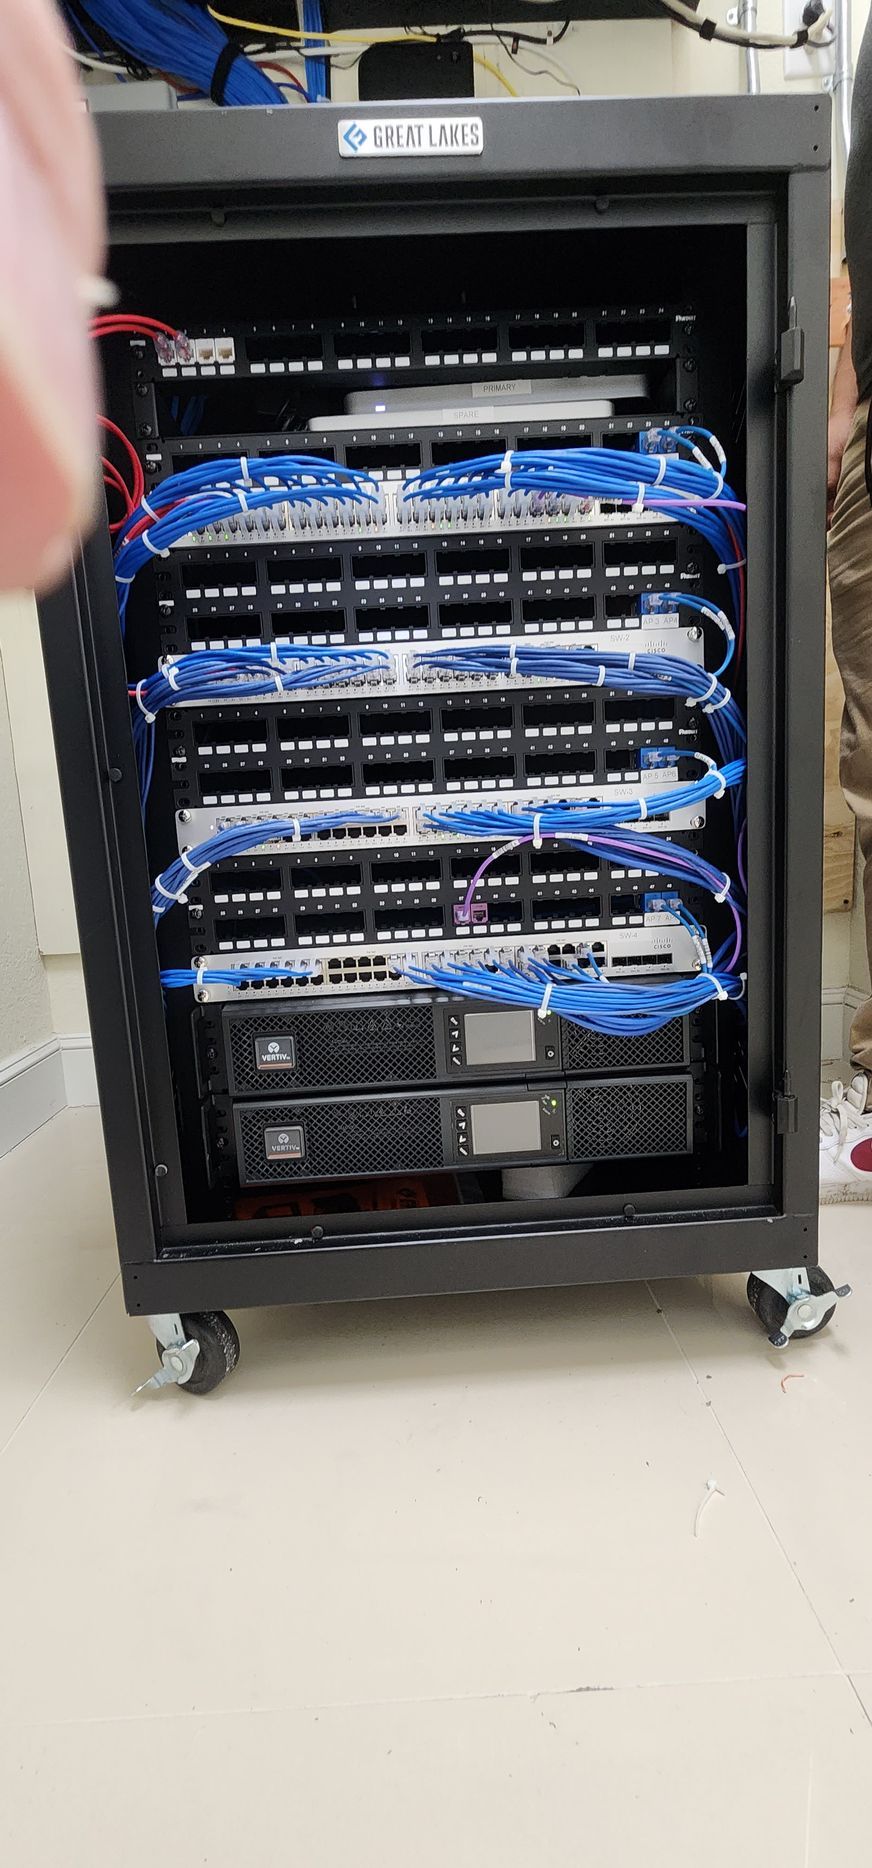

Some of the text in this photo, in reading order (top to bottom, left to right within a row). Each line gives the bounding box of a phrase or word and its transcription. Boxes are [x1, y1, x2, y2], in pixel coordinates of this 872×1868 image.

[373, 122, 480, 149] GREAT LAKES
[483, 383, 517, 393] PRIMARY
[454, 410, 479, 419] SPARE
[262, 1053, 287, 1062] VERTIV
[271, 1144, 296, 1152] VERTIV
